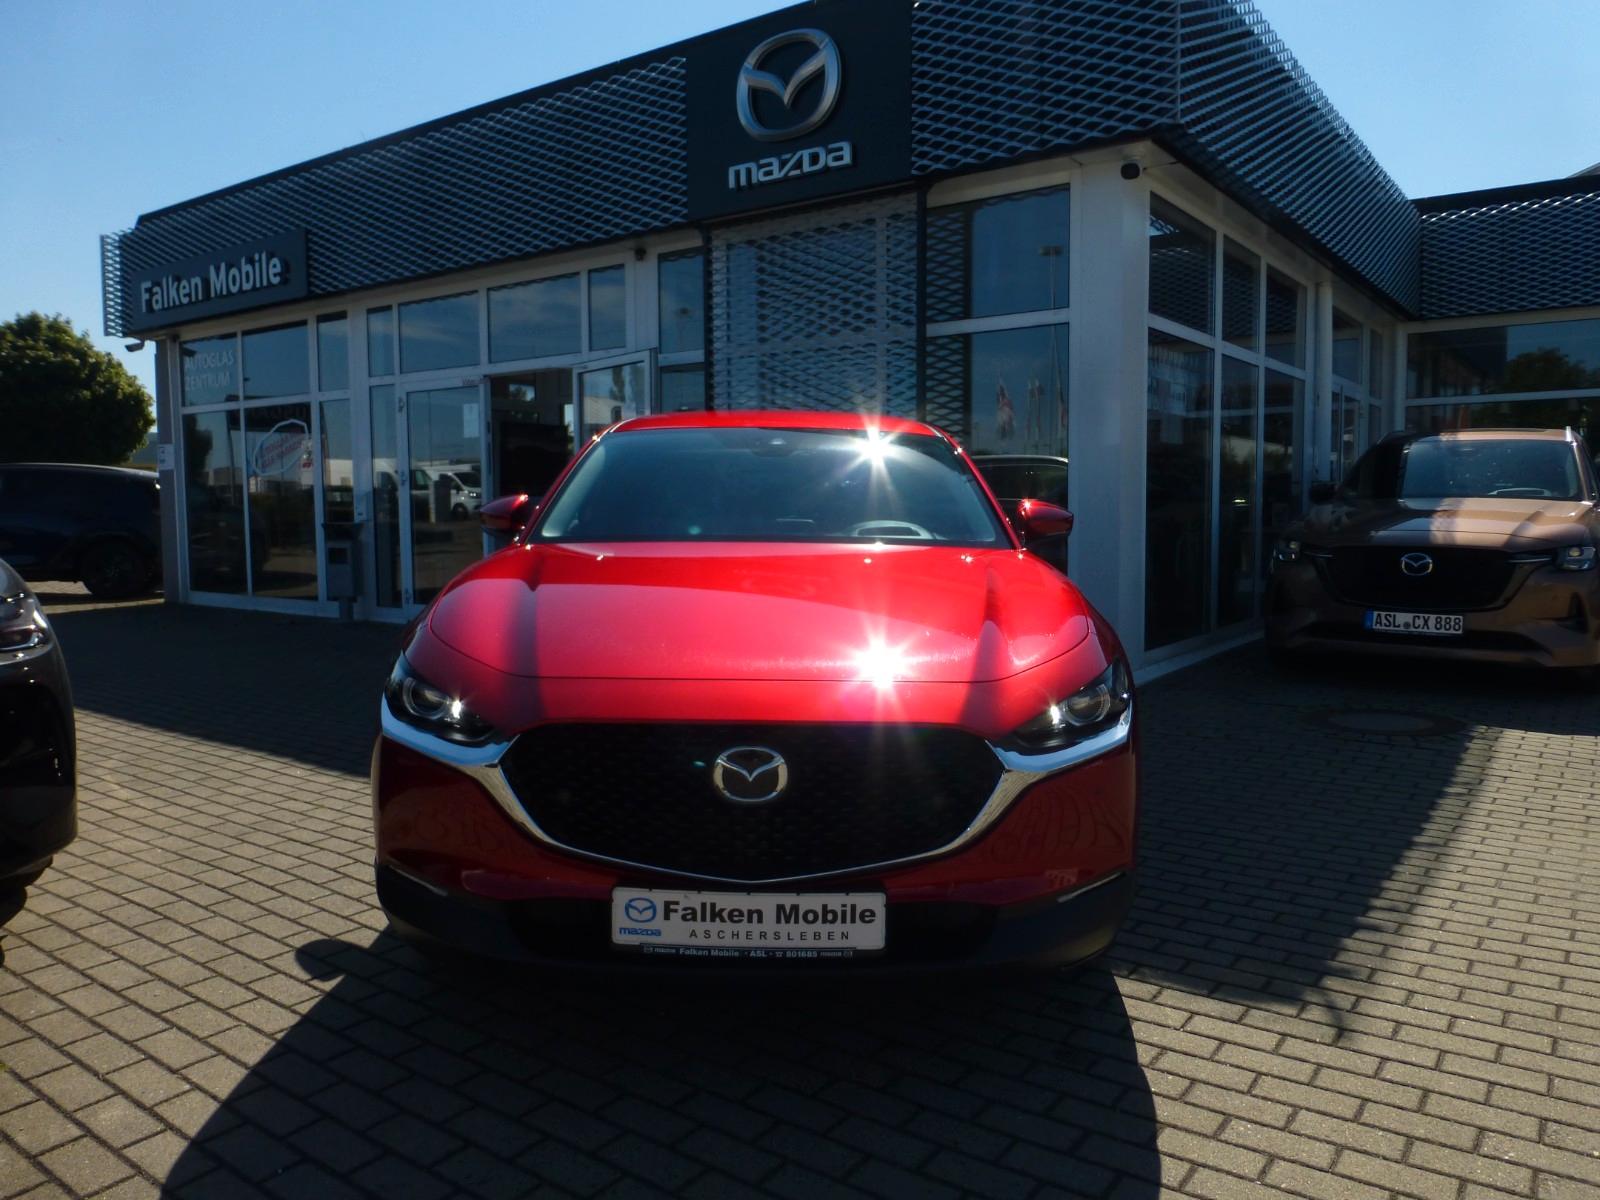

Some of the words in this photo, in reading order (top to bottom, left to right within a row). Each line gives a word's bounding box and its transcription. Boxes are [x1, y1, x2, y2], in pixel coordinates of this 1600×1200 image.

[141, 276, 203, 312] Falken
[209, 251, 282, 298] Mobile
[1375, 613, 1400, 628] ASL
[1412, 615, 1430, 630] CX
[1434, 616, 1462, 631] 888
[663, 900, 763, 924] Falken
[775, 904, 876, 924] Mobile
[689, 929, 849, 940] ASCHERSLEBEN
